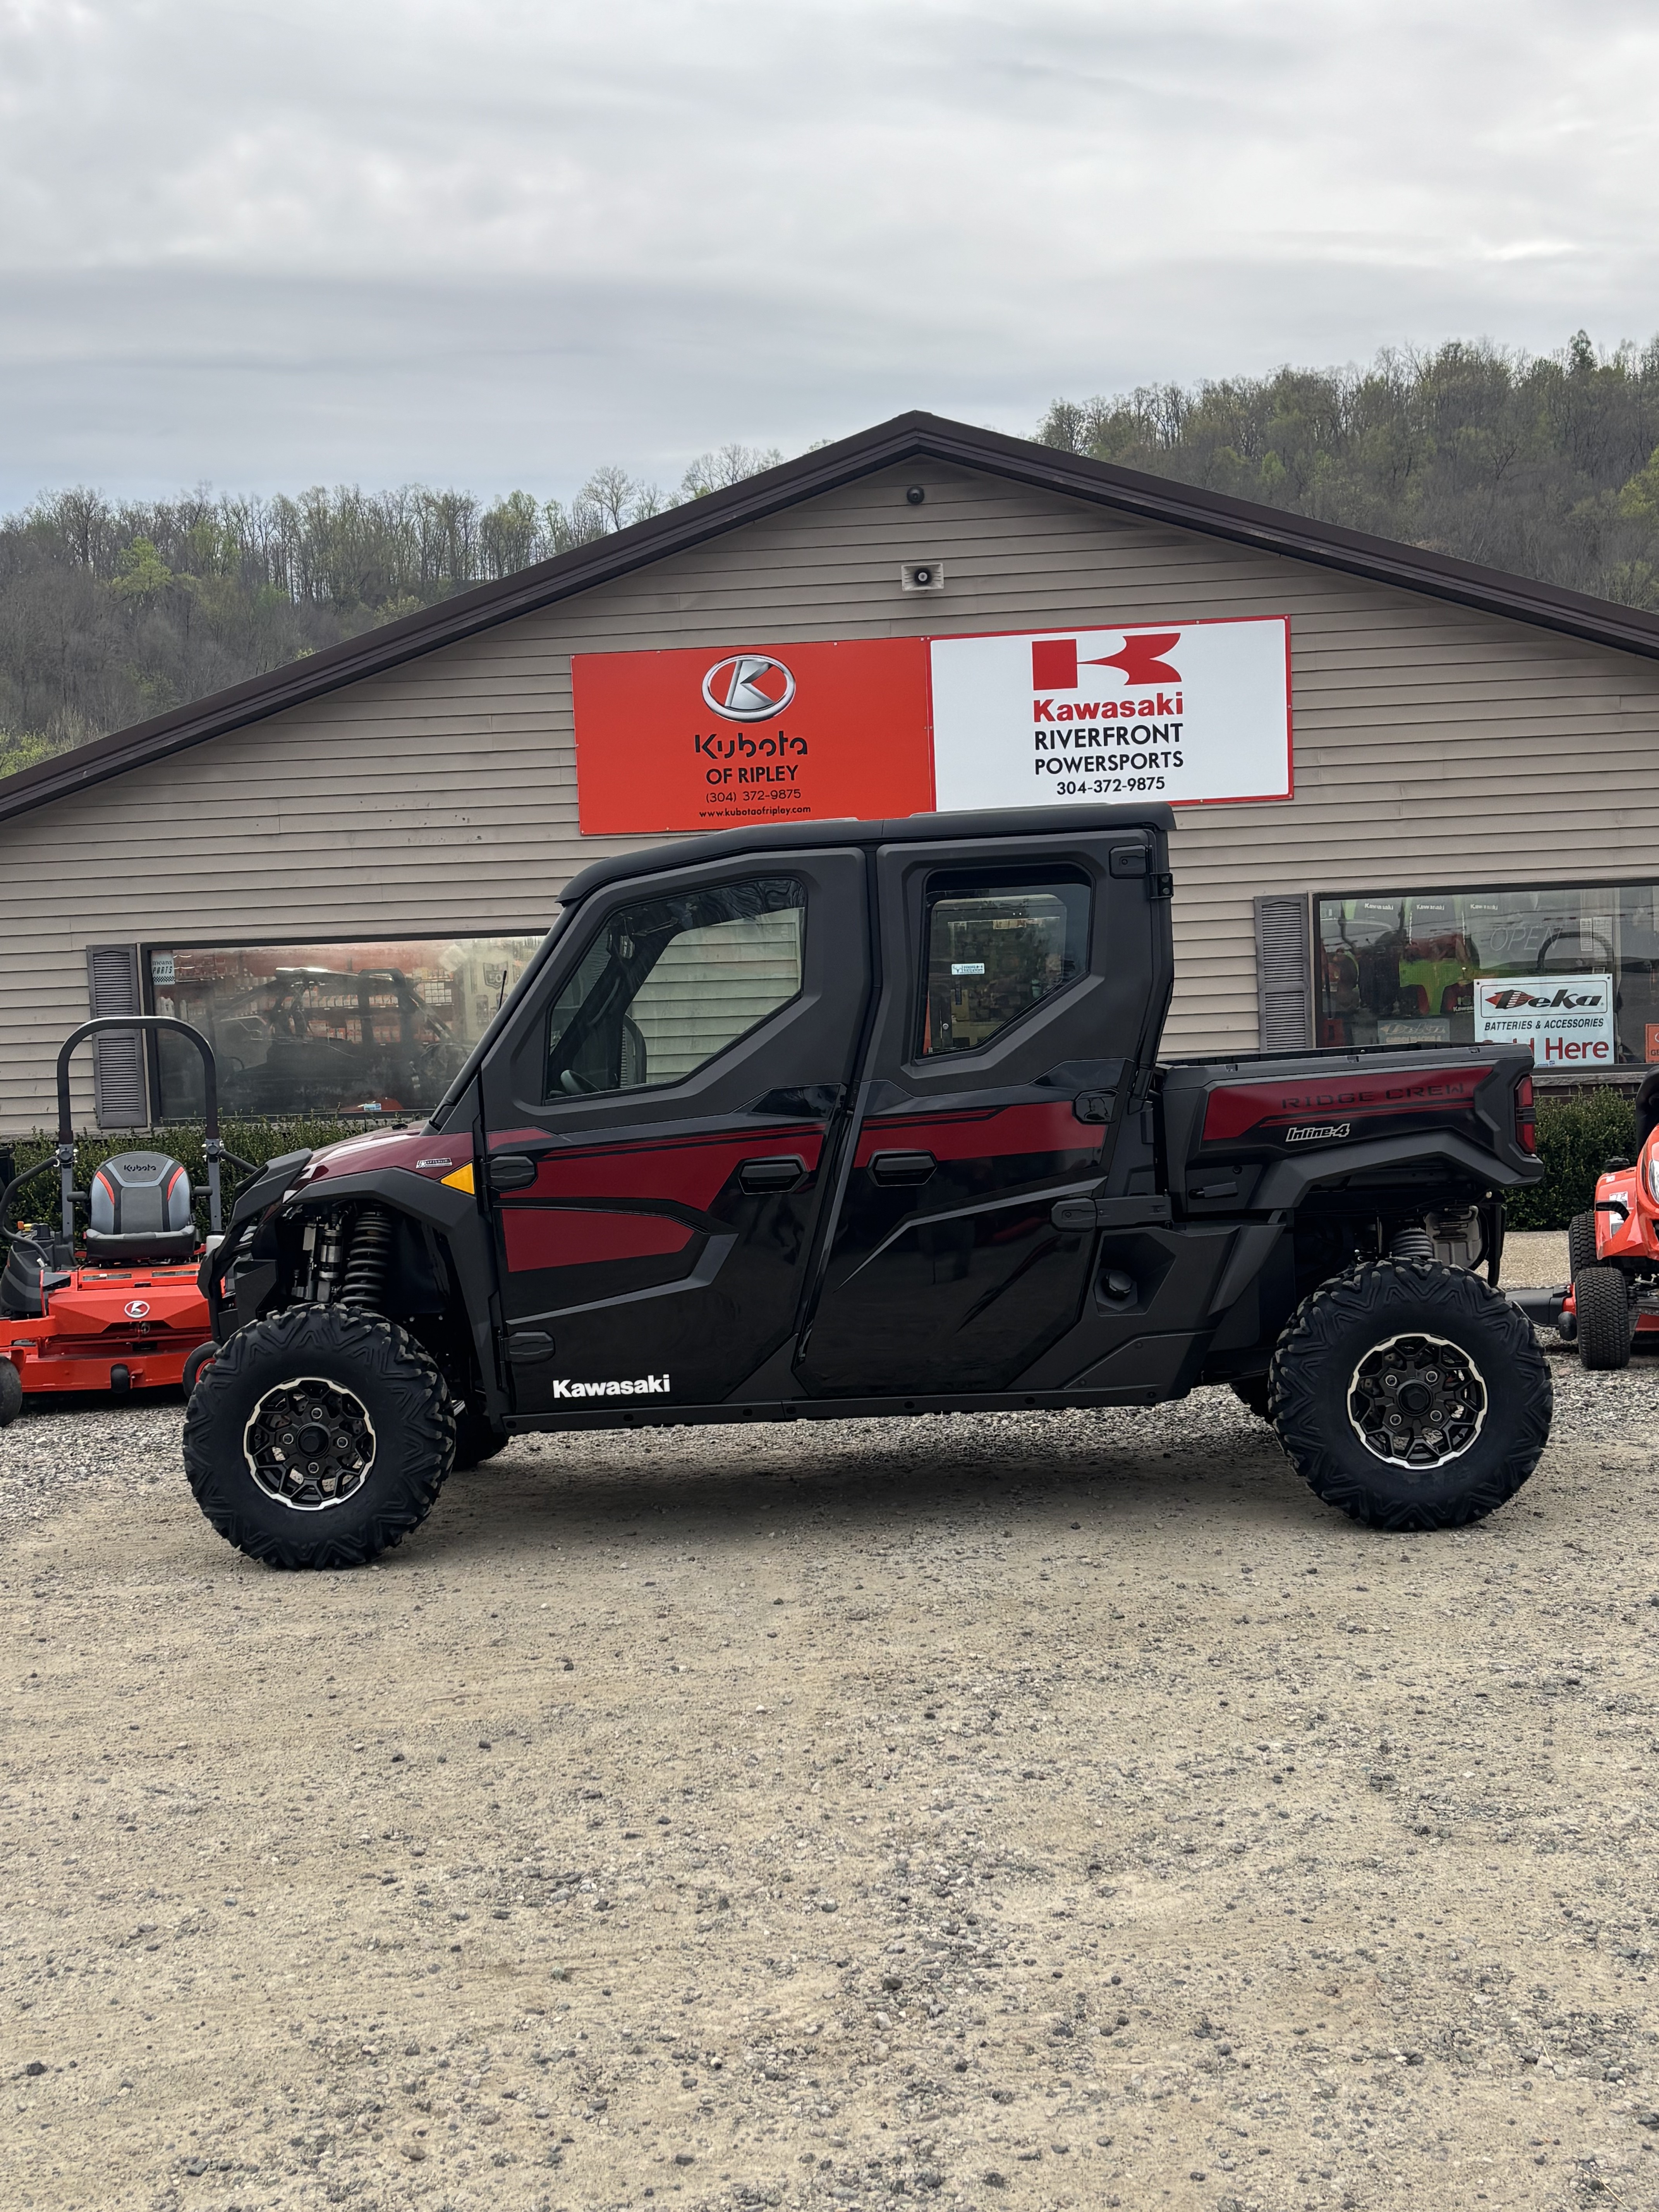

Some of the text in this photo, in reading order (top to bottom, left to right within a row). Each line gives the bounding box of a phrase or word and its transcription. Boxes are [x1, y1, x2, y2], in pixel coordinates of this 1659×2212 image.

[1034, 692, 1183, 722] Kawasaki
[695, 730, 808, 759] Kubota
[1035, 723, 1183, 750] RIVERFRONT
[1035, 750, 1184, 775] POWERSPORTS
[706, 764, 799, 785] OF RIPLEY
[1056, 776, 1165, 795] 304-372-9875
[706, 788, 801, 803] (304) 372-9875
[1491, 927, 1562, 951] OPEN
[1487, 989, 1602, 1010] Deka
[1484, 1020, 1532, 1031] BATTERIES
[1544, 1018, 1604, 1029] ACCESSORIES
[1545, 1037, 1609, 1060] Here
[1282, 1083, 1464, 1109] RIDGE CREW
[1285, 1123, 1350, 1142] Inline-4
[553, 1374, 670, 1398] Kawasaki
